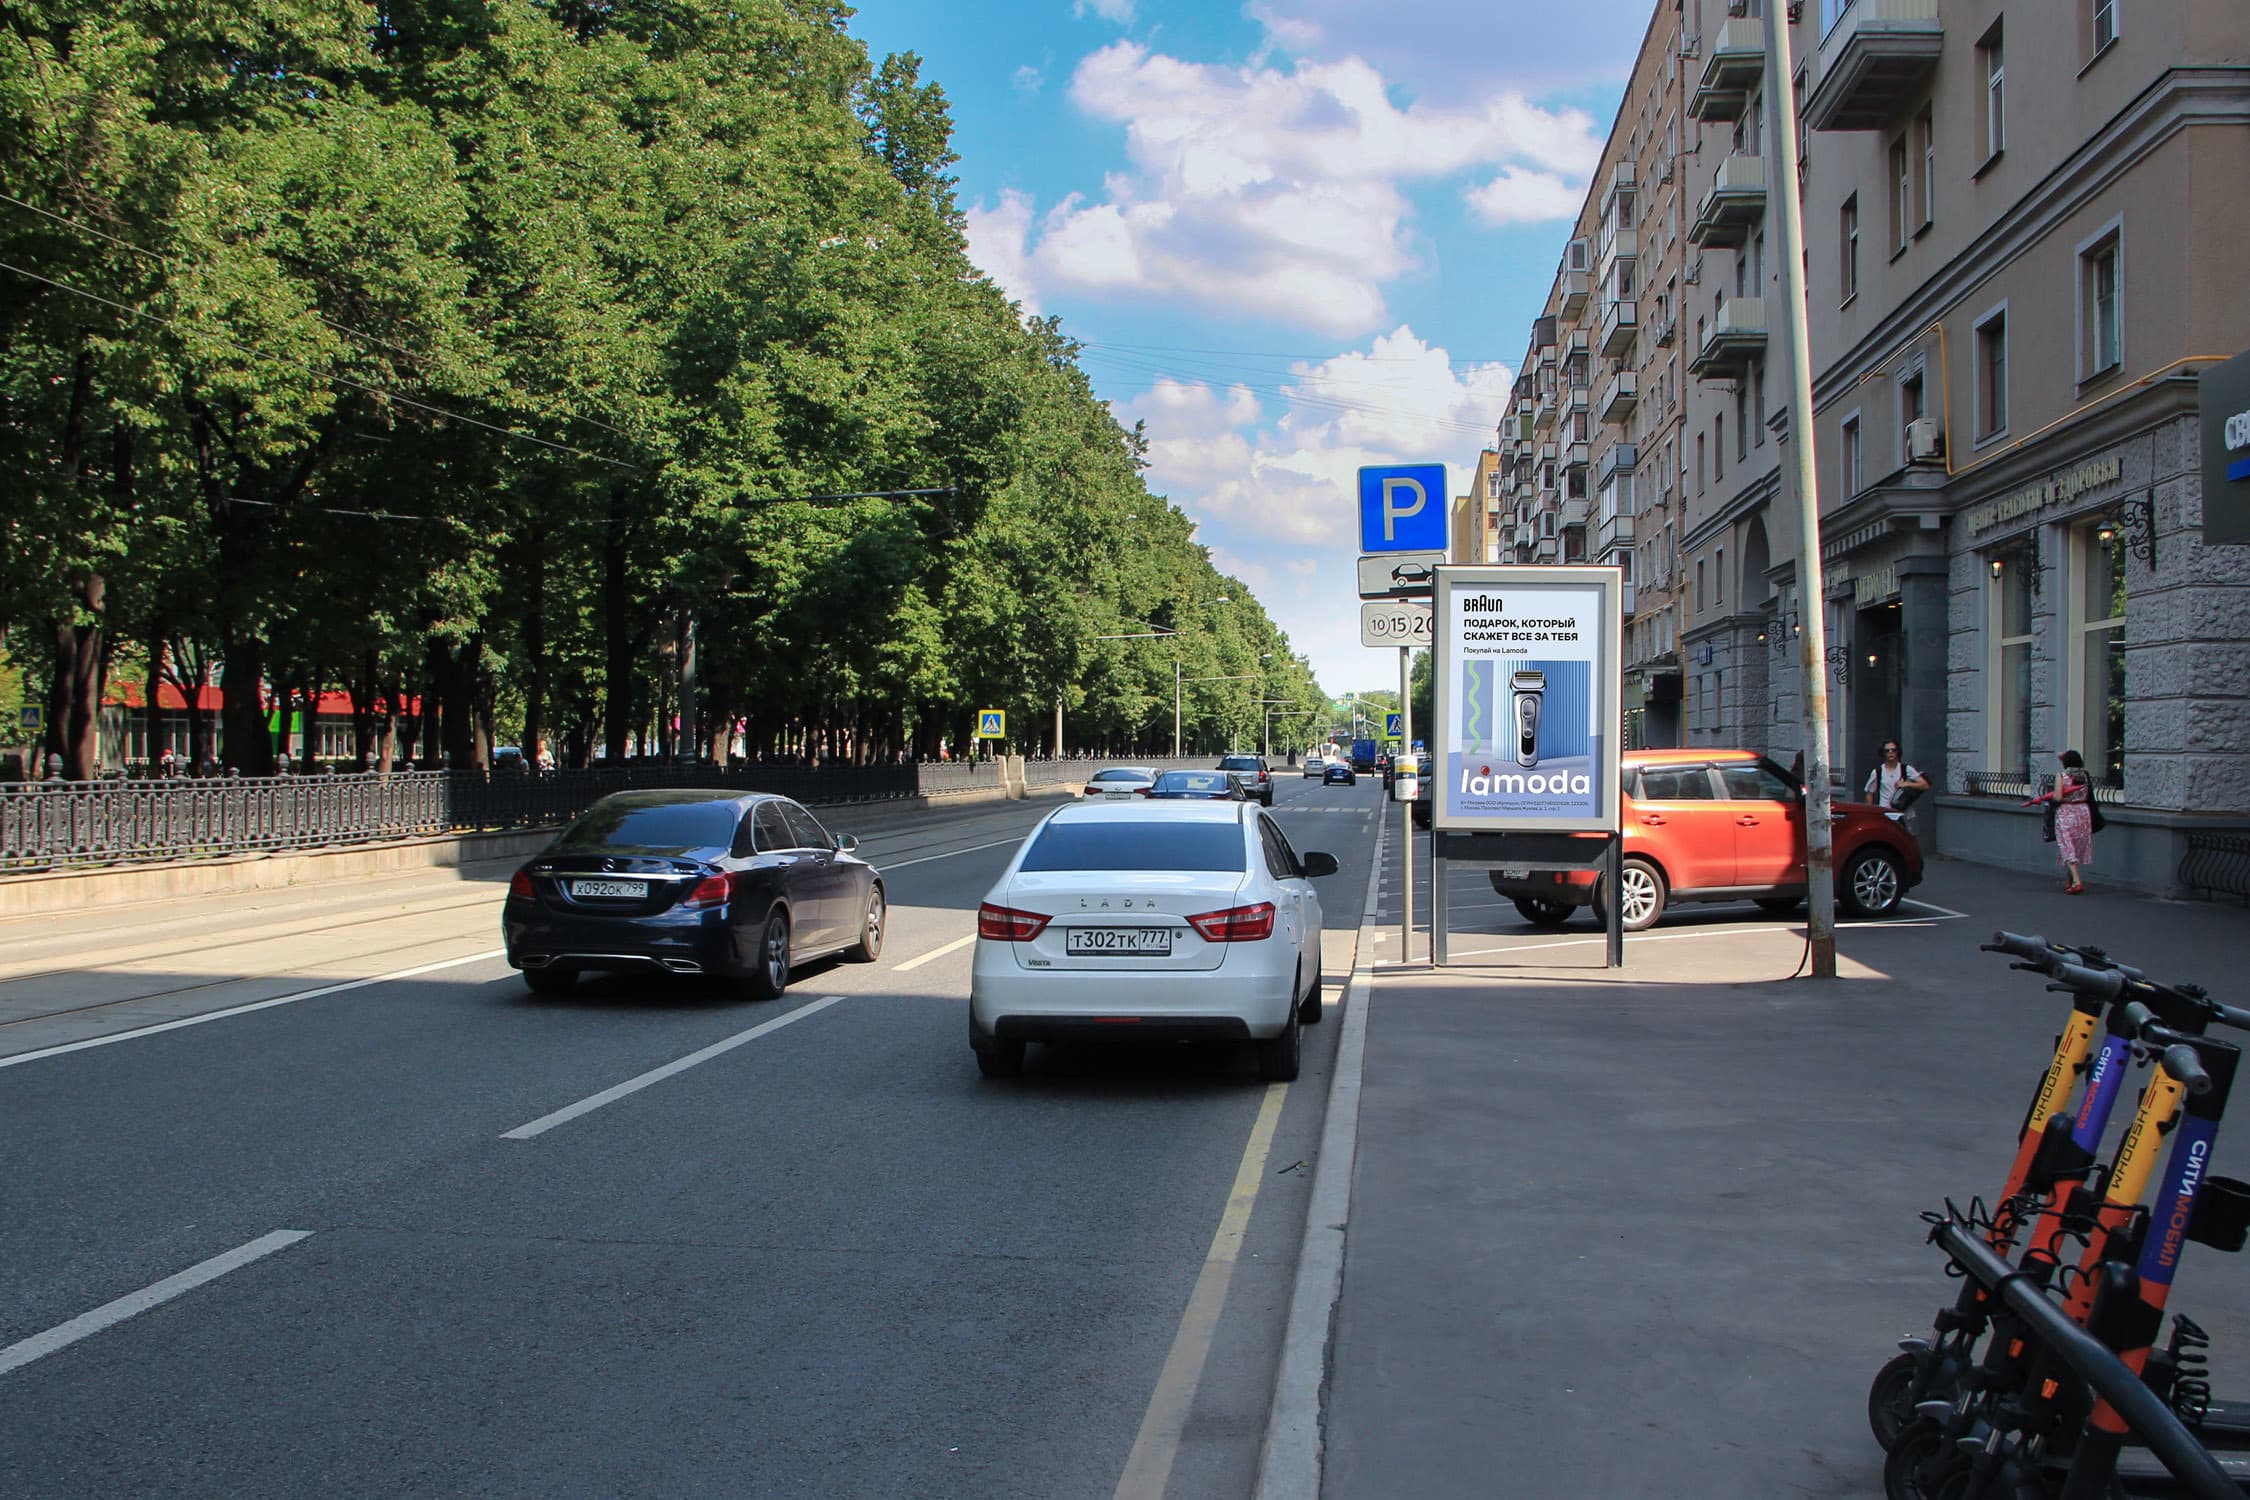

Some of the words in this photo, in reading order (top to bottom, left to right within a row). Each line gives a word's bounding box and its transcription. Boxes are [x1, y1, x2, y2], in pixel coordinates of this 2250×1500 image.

[2056, 455, 2122, 503] ЗДОРОВЬЯ
[1383, 477, 1426, 541] P
[1464, 595, 1503, 612] BRAUN
[1372, 619, 1385, 631] 10
[1391, 617, 1406, 632] 15
[1464, 618, 1520, 629] ПОДАРОК,
[1522, 617, 1576, 628] КОТОРЫЙ
[1463, 632, 1509, 641] СКАЖЕТ
[1512, 632, 1533, 641] ВСЕ
[1534, 632, 1549, 641] ЗА
[1551, 632, 1578, 641] ТЕБЯ
[1464, 647, 1491, 655] Покупай
[1460, 768, 1590, 797] lamoda
[1081, 898, 1155, 908] LADA
[1141, 930, 1166, 943] 777
[2034, 1054, 2066, 1122] WHOOSH
[2112, 1109, 2148, 1189] WHOOSH
